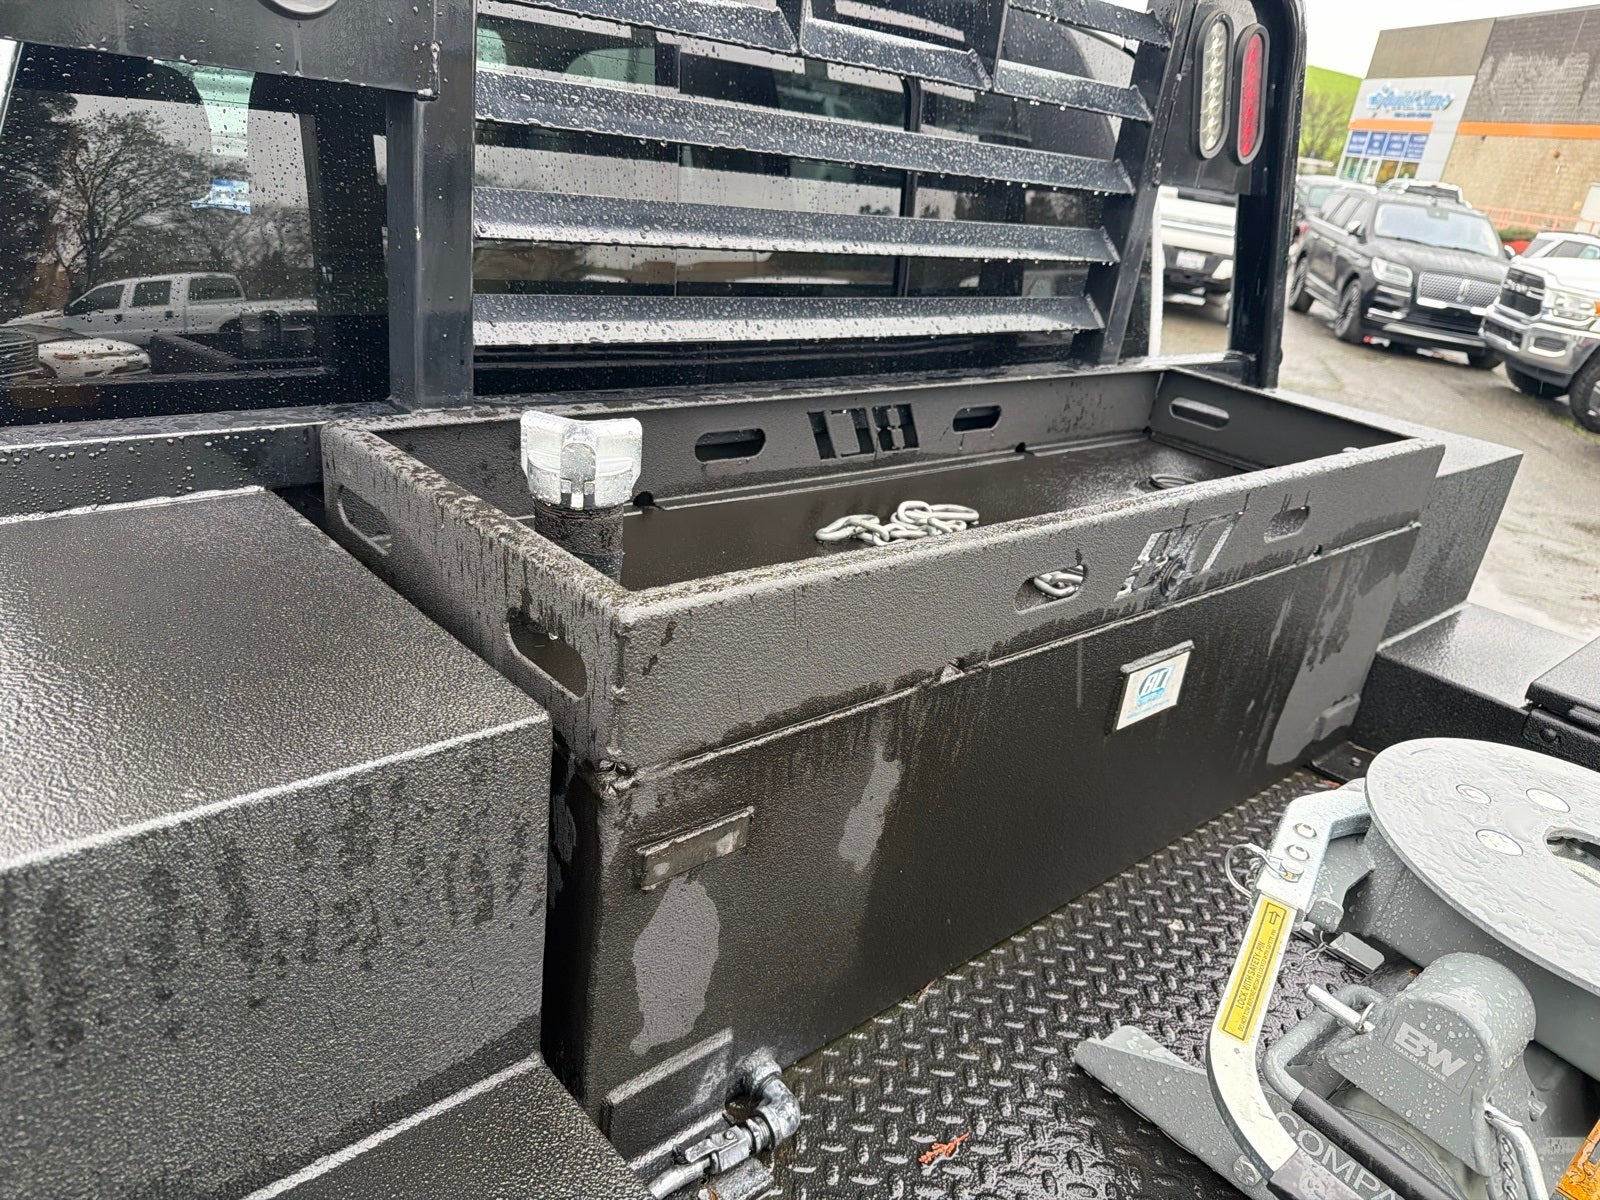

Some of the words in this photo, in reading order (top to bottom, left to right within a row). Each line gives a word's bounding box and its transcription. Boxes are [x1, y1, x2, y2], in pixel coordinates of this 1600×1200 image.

[1236, 989, 1247, 1009] LOCK
[1242, 973, 1253, 991] WITH
[1246, 989, 1256, 1006] BEFORE
[1251, 977, 1260, 990] HITCH
[1257, 958, 1266, 974] LOCKED
[1392, 1043, 1418, 1064] TRAILER
